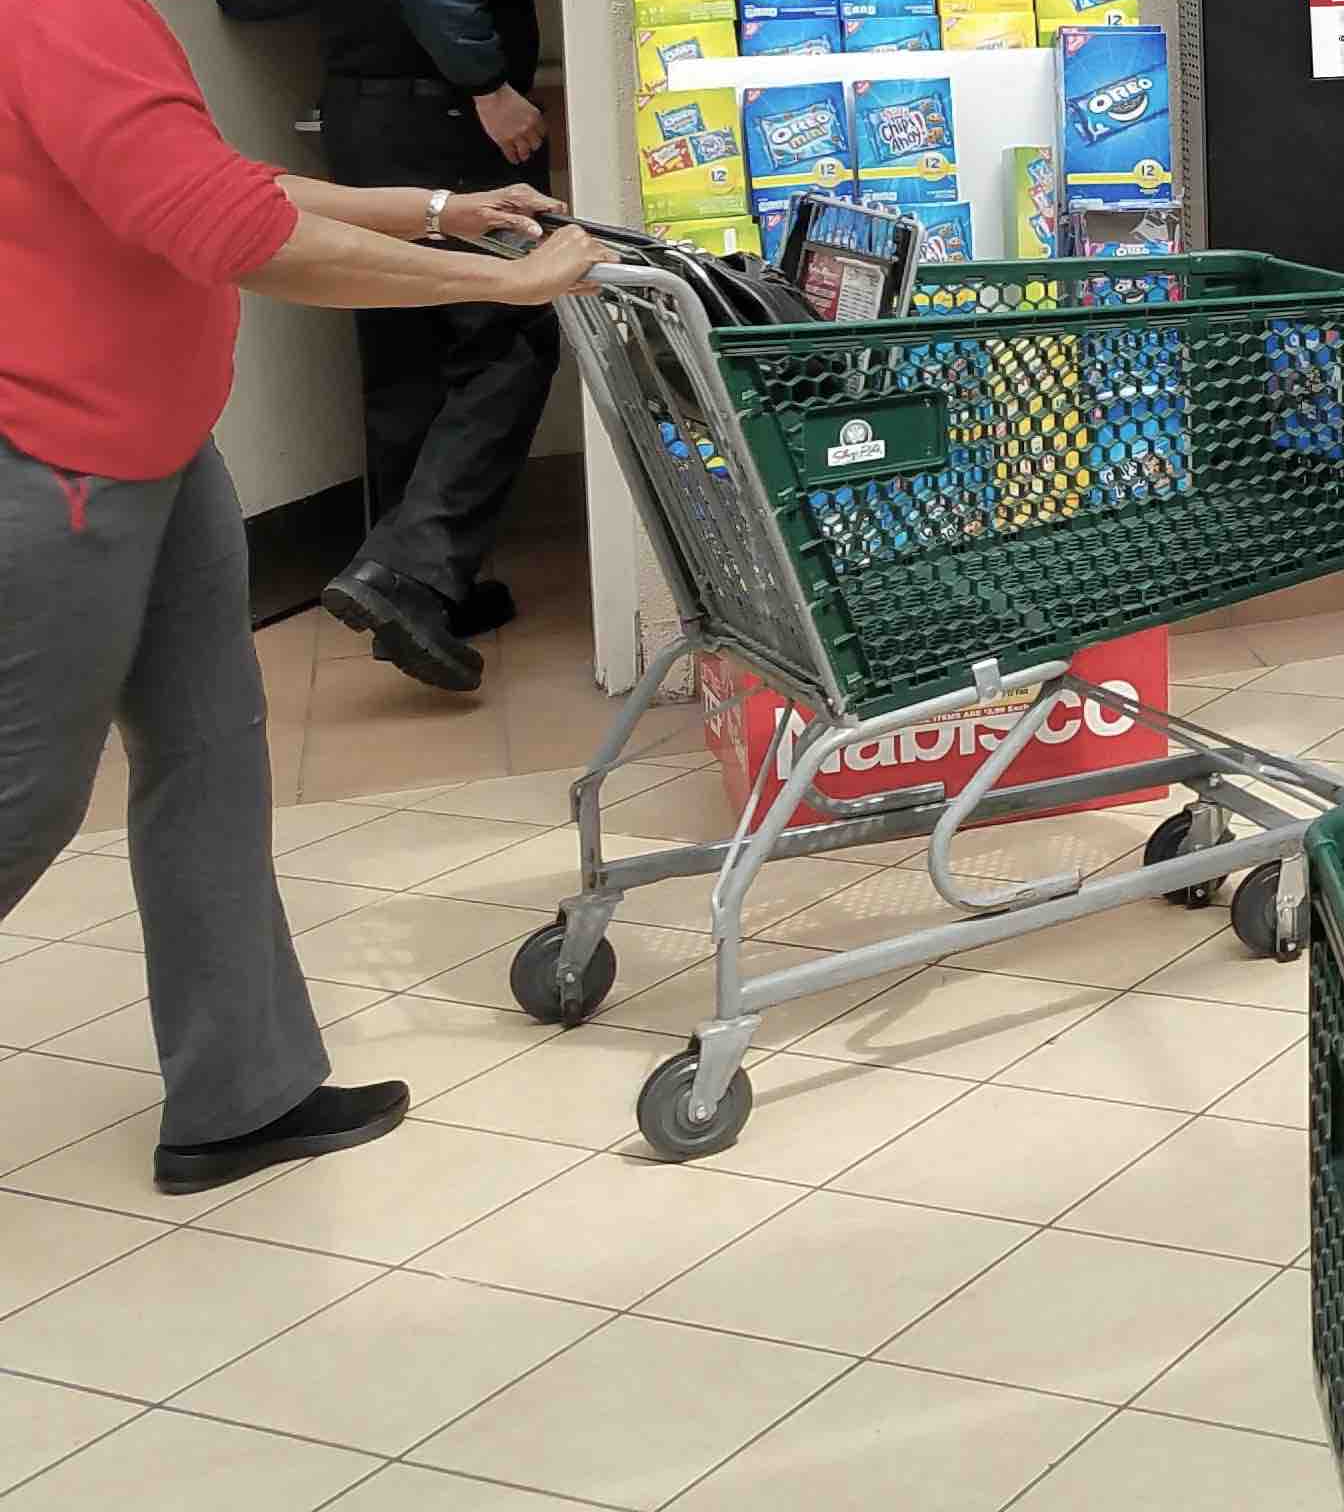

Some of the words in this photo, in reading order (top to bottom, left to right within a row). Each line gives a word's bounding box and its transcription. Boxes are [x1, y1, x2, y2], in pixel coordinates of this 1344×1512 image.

[1107, 15, 1123, 26] 12
[1088, 76, 1152, 114] OREO
[771, 109, 832, 145] OREO
[821, 163, 836, 175] 12
[925, 158, 940, 169] 12
[711, 170, 727, 182] 12
[1140, 165, 1154, 177] 12
